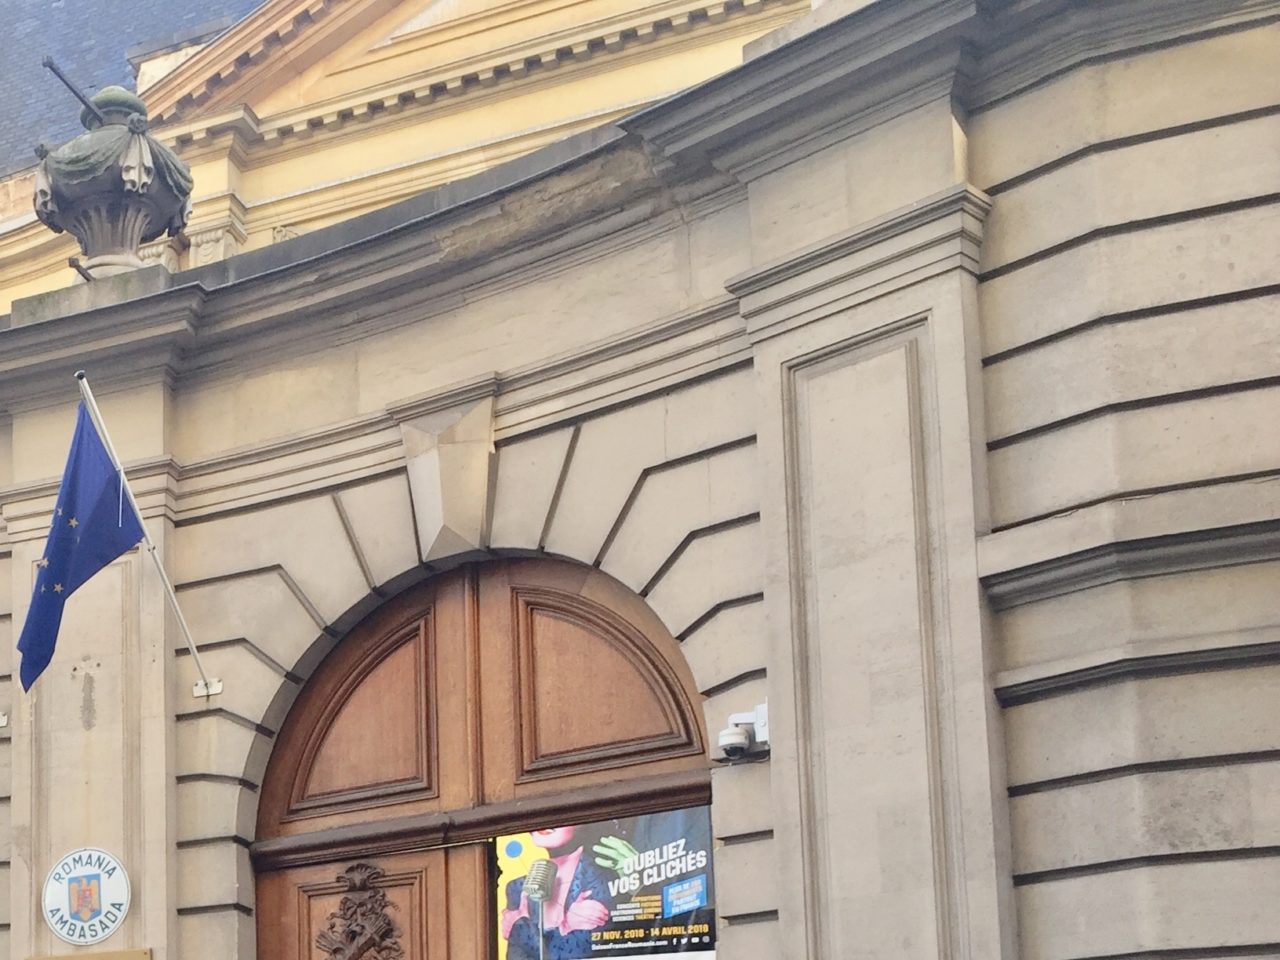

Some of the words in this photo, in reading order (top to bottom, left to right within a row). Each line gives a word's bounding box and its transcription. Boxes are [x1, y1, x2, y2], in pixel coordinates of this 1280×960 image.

[53, 853, 118, 884] ROMANIA
[608, 873, 640, 897] VOS
[643, 850, 707, 886] CLICHÉS
[623, 838, 687, 875] OUBLIEZ
[49, 901, 124, 940] AMBASADA
[591, 932, 601, 941] 27
[603, 931, 623, 940] NOV.
[650, 927, 660, 937] 14
[661, 925, 686, 936] AVRIL
